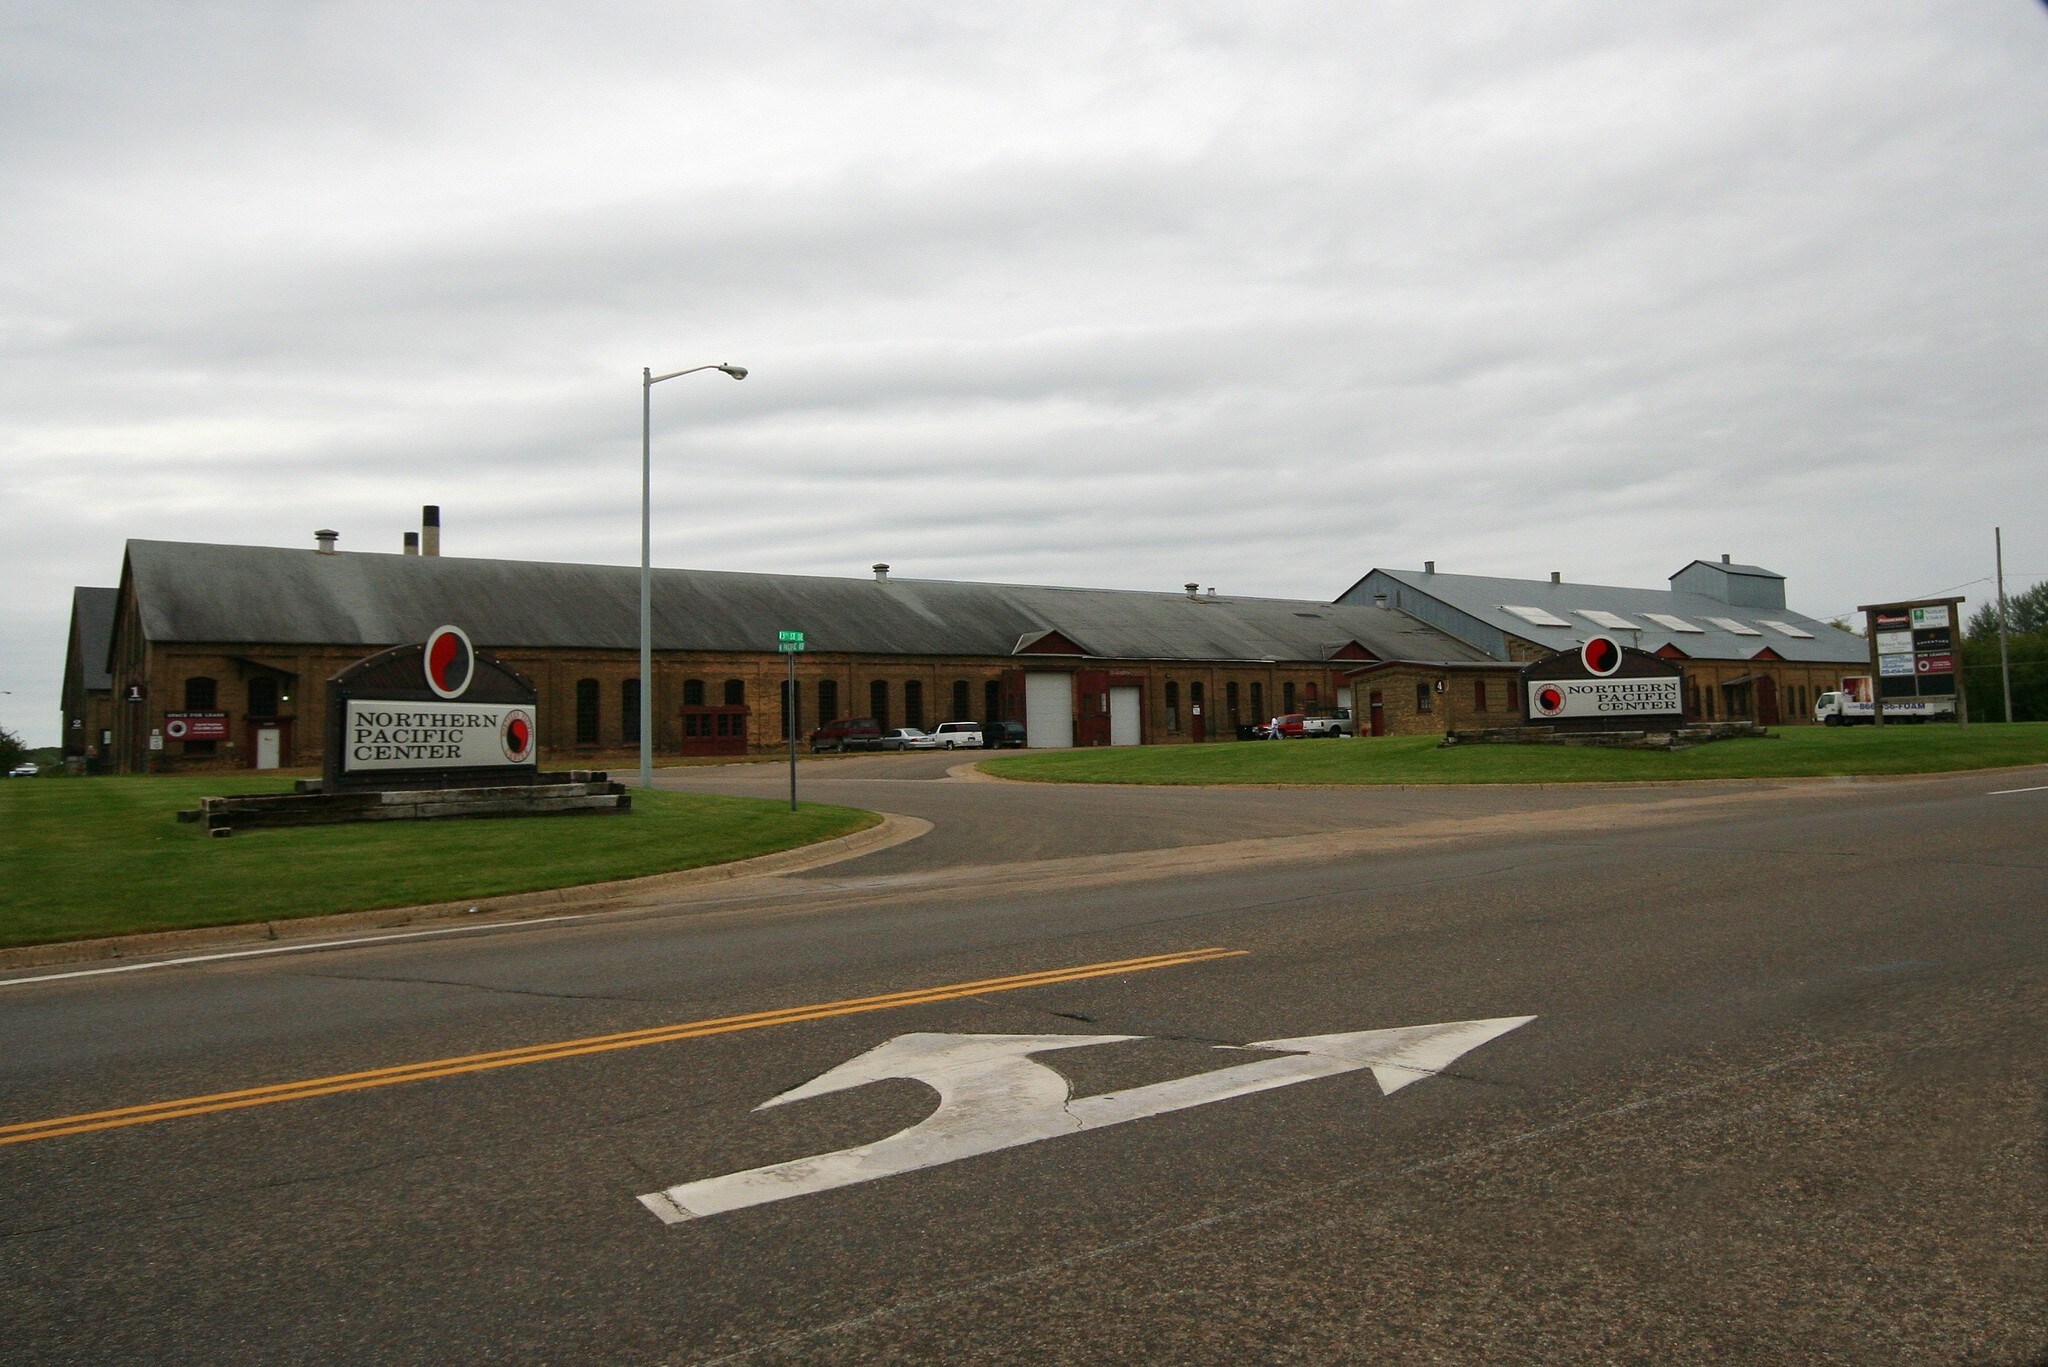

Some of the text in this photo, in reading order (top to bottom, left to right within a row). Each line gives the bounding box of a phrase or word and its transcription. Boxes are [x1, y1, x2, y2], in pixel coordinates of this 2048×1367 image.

[1437, 681, 1443, 691] 4
[1568, 683, 1677, 694] NORTHERN
[130, 686, 140, 698] 1
[1597, 692, 1677, 702] PACIFIC
[1597, 701, 1677, 711] CENTER
[73, 719, 82, 727] 2
[355, 712, 498, 728] NORTHERN
[354, 729, 464, 744] PACIFIC
[353, 745, 462, 761] CENTER
